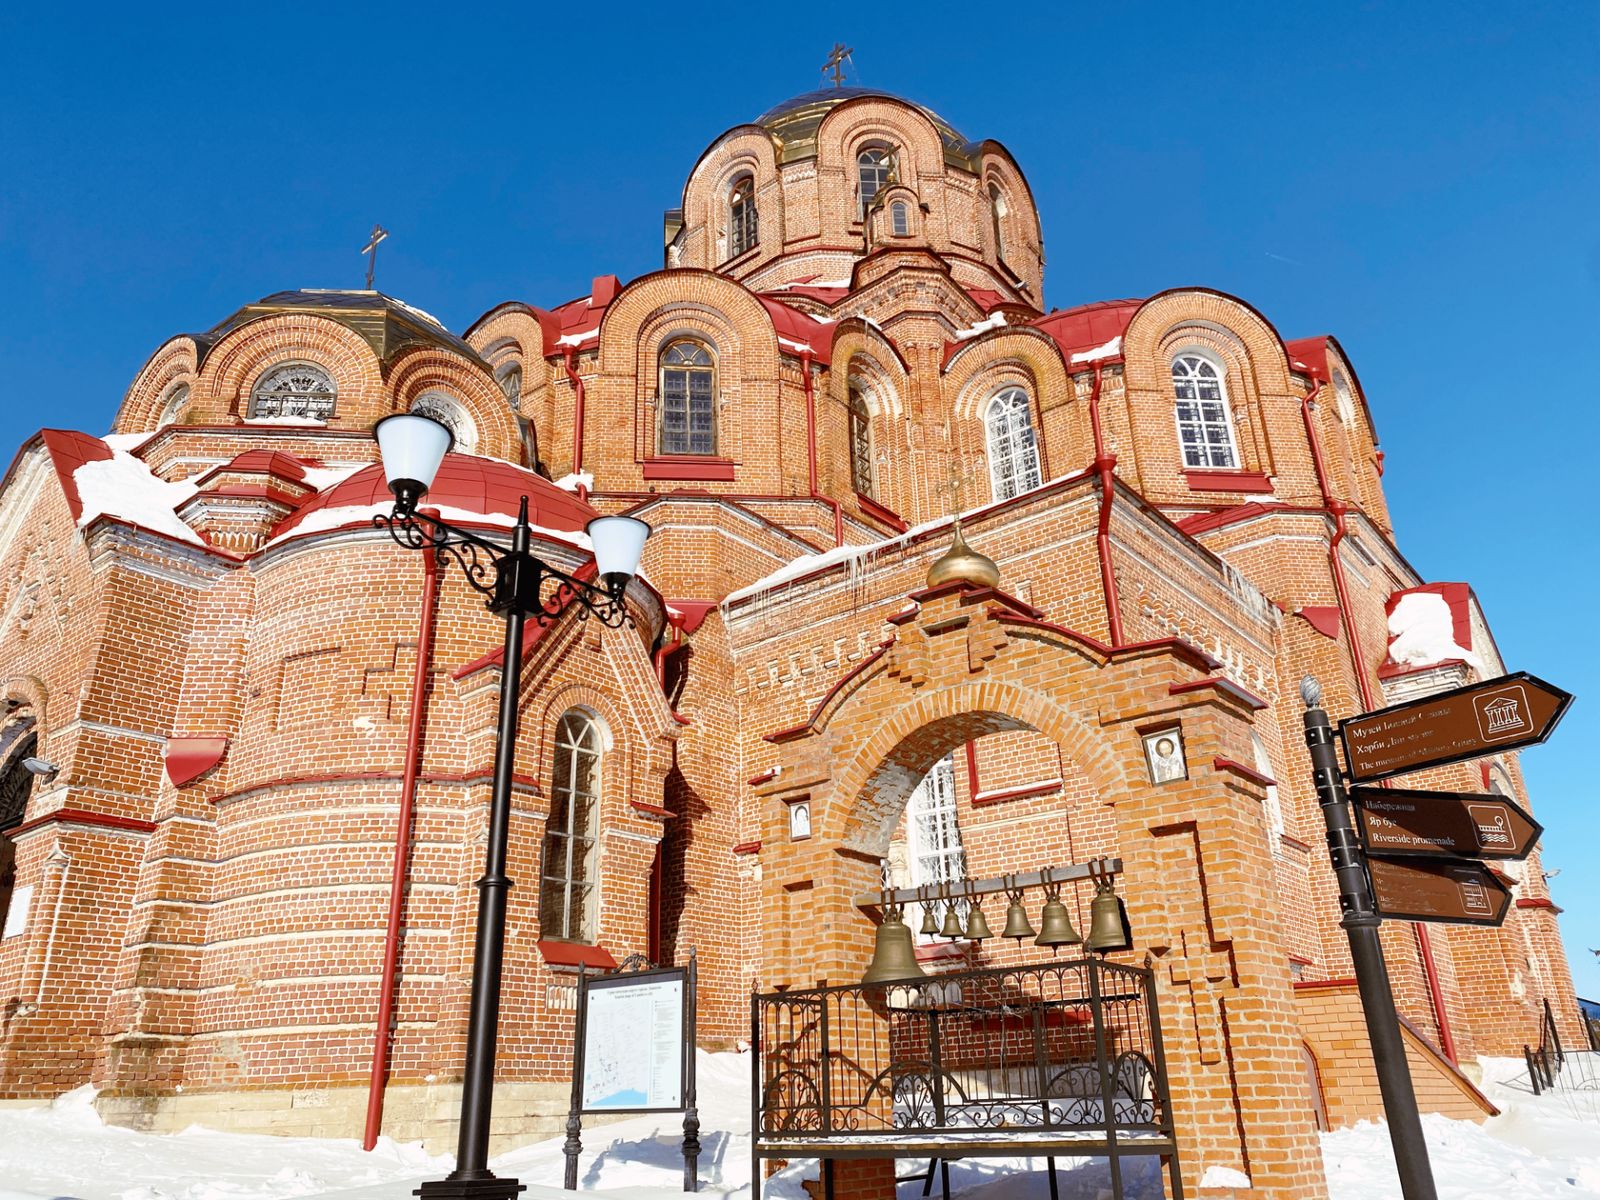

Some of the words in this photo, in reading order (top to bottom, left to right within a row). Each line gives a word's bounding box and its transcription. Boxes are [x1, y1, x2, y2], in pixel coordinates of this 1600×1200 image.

[1352, 725, 1382, 738] Музей
[1356, 740, 1385, 754] Хәрби
[1359, 762, 1375, 771] The
[1369, 816, 1382, 827] Яр
[1372, 832, 1411, 844] Riverside
[1412, 836, 1456, 846] promenade
